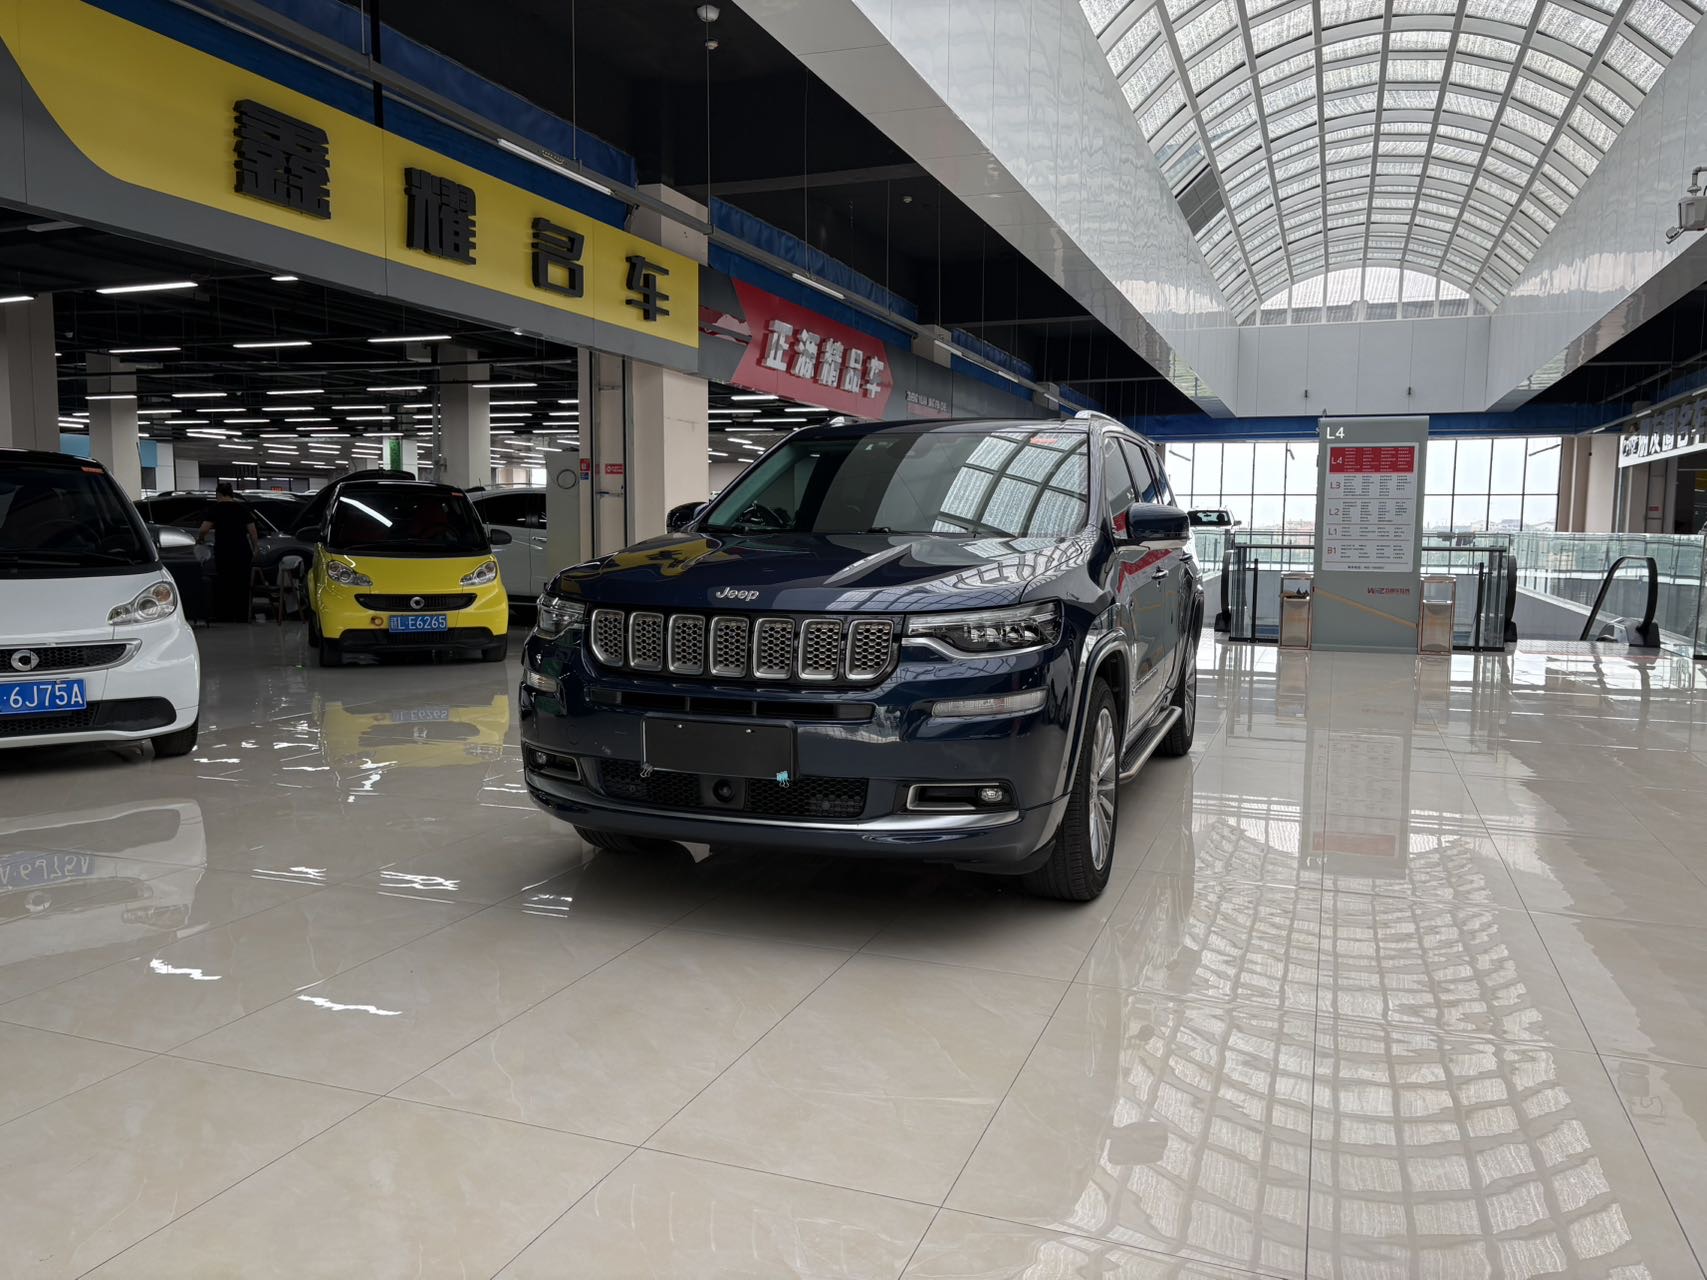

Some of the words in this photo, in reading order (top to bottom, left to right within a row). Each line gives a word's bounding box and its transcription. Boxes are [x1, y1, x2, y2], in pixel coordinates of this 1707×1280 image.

[233, 99, 670, 322] 鑫耀名车
[1326, 426, 1345, 439] L4
[1331, 456, 1343, 465] L4
[1330, 481, 1341, 490] L3
[1328, 508, 1340, 516] L2
[1328, 528, 1338, 536] L1
[1327, 546, 1337, 555] B1
[715, 586, 760, 602] Jeep
